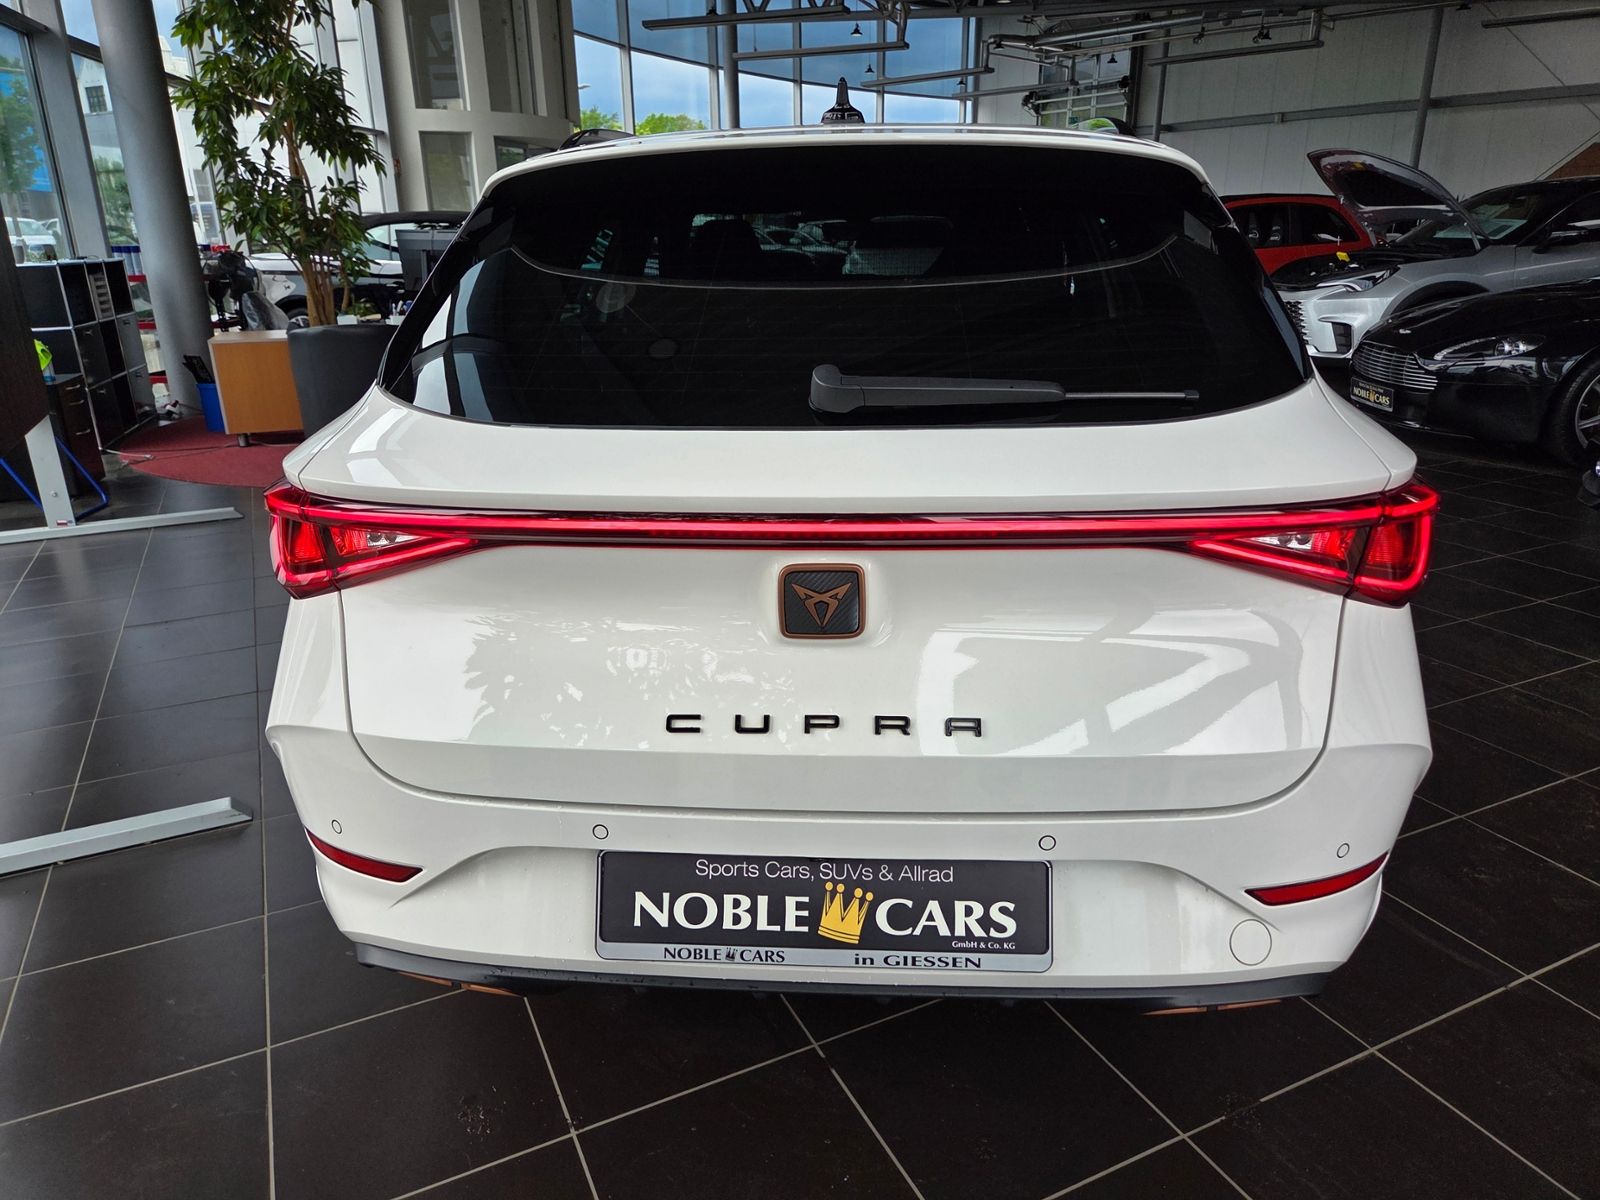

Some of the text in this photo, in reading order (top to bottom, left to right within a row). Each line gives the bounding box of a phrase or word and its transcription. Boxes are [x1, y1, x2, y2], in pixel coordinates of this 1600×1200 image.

[665, 714, 982, 737] CUPRA
[696, 859, 954, 883] Sports Cars, SUVs & Allrad
[633, 891, 1017, 938] NOBLE CARS
[952, 940, 1015, 950] GmbH & Co. KG
[664, 947, 785, 963] NOBLE CARS
[854, 953, 981, 969] in GIESSEN
